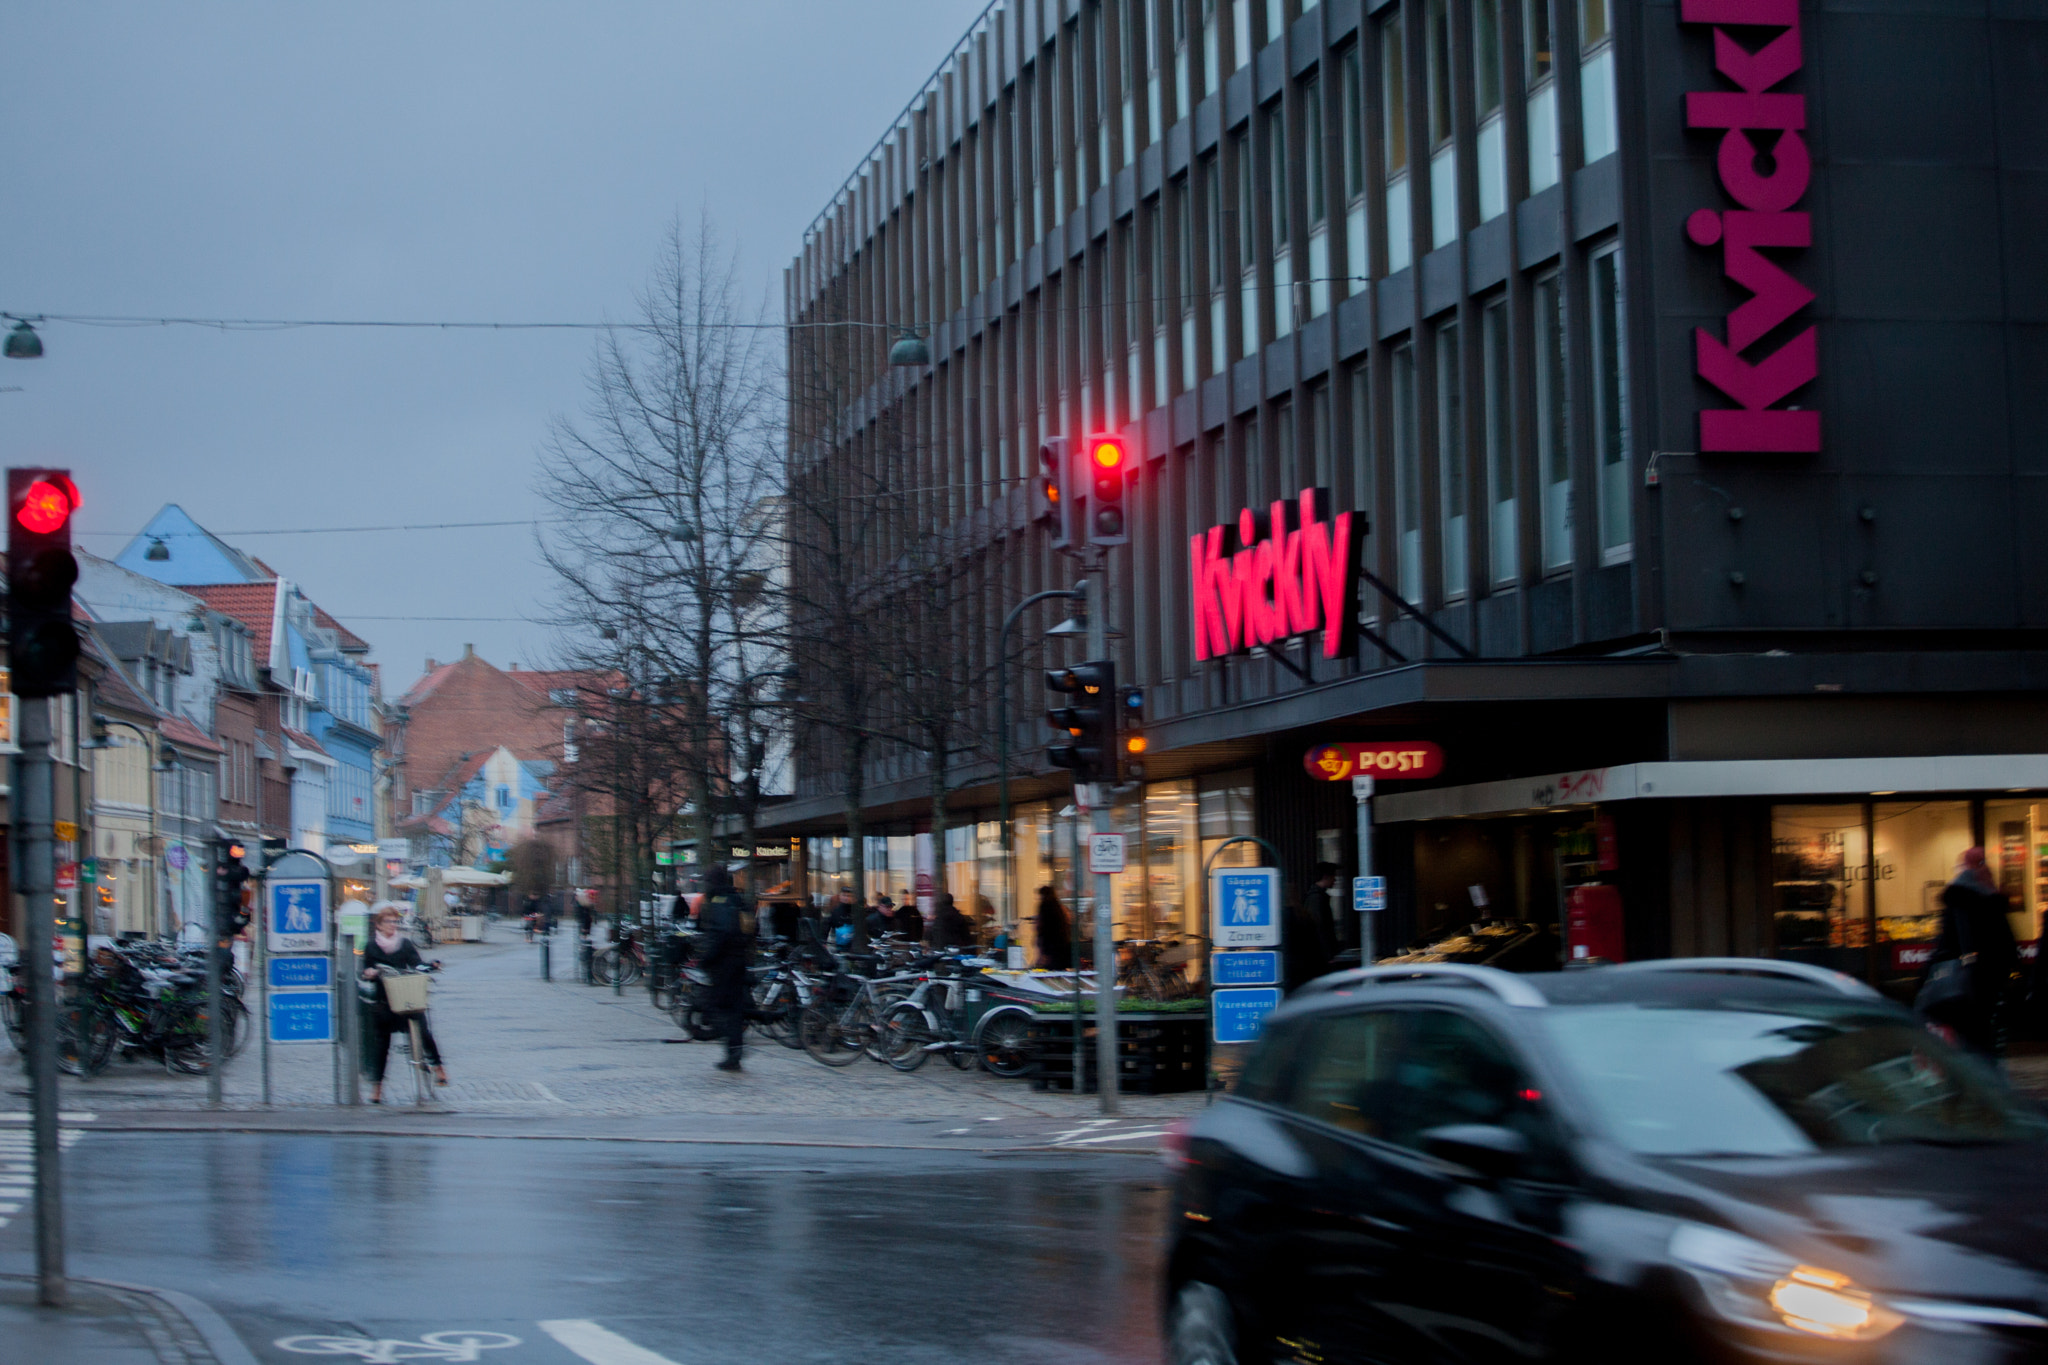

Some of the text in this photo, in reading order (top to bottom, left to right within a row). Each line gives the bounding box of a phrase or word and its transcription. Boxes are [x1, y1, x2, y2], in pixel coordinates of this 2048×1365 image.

[1191, 487, 1355, 661] Kvickly
[1359, 750, 1427, 772] POST
[280, 937, 317, 949] Zone
[1227, 930, 1265, 942] Zone
